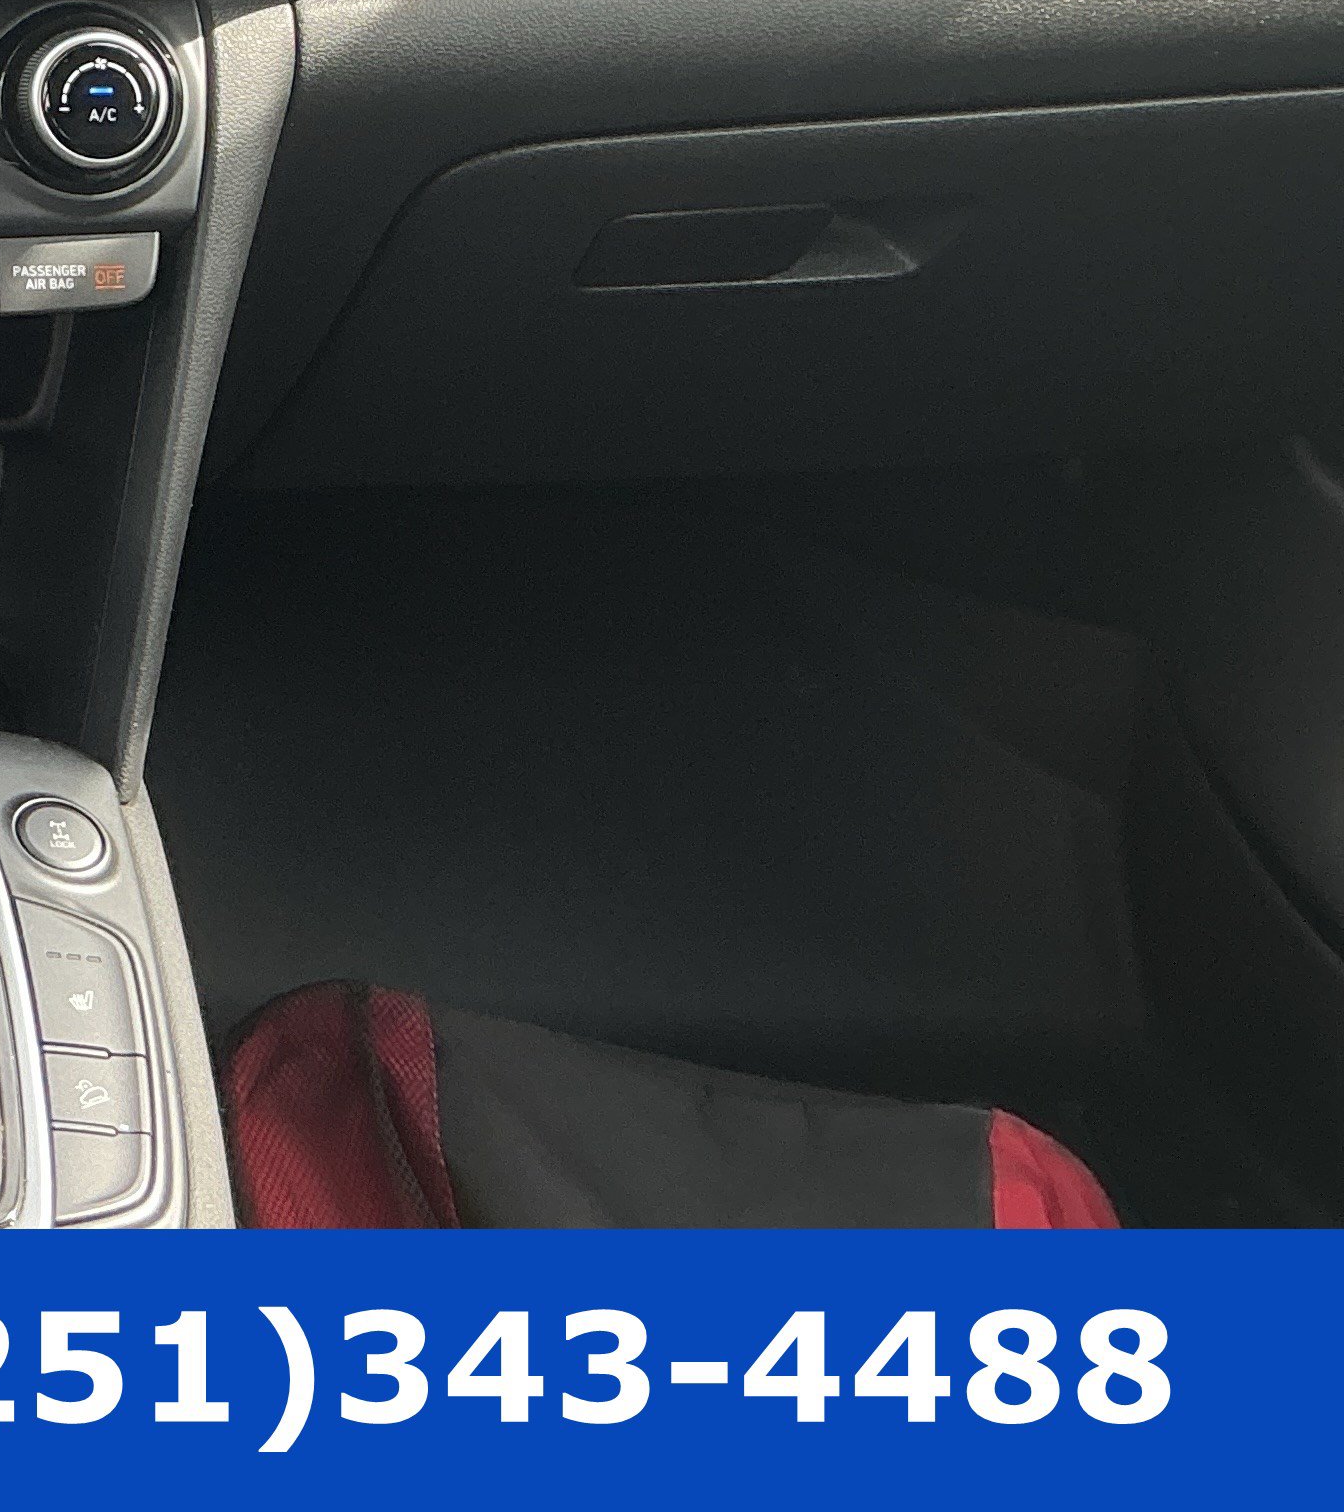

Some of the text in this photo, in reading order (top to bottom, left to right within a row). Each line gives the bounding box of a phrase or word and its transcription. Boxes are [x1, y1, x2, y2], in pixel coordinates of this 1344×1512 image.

[89, 107, 117, 123] A/C
[12, 265, 86, 278] PASSENGER
[94, 269, 125, 285] OFF
[25, 278, 75, 290] AIR BAG
